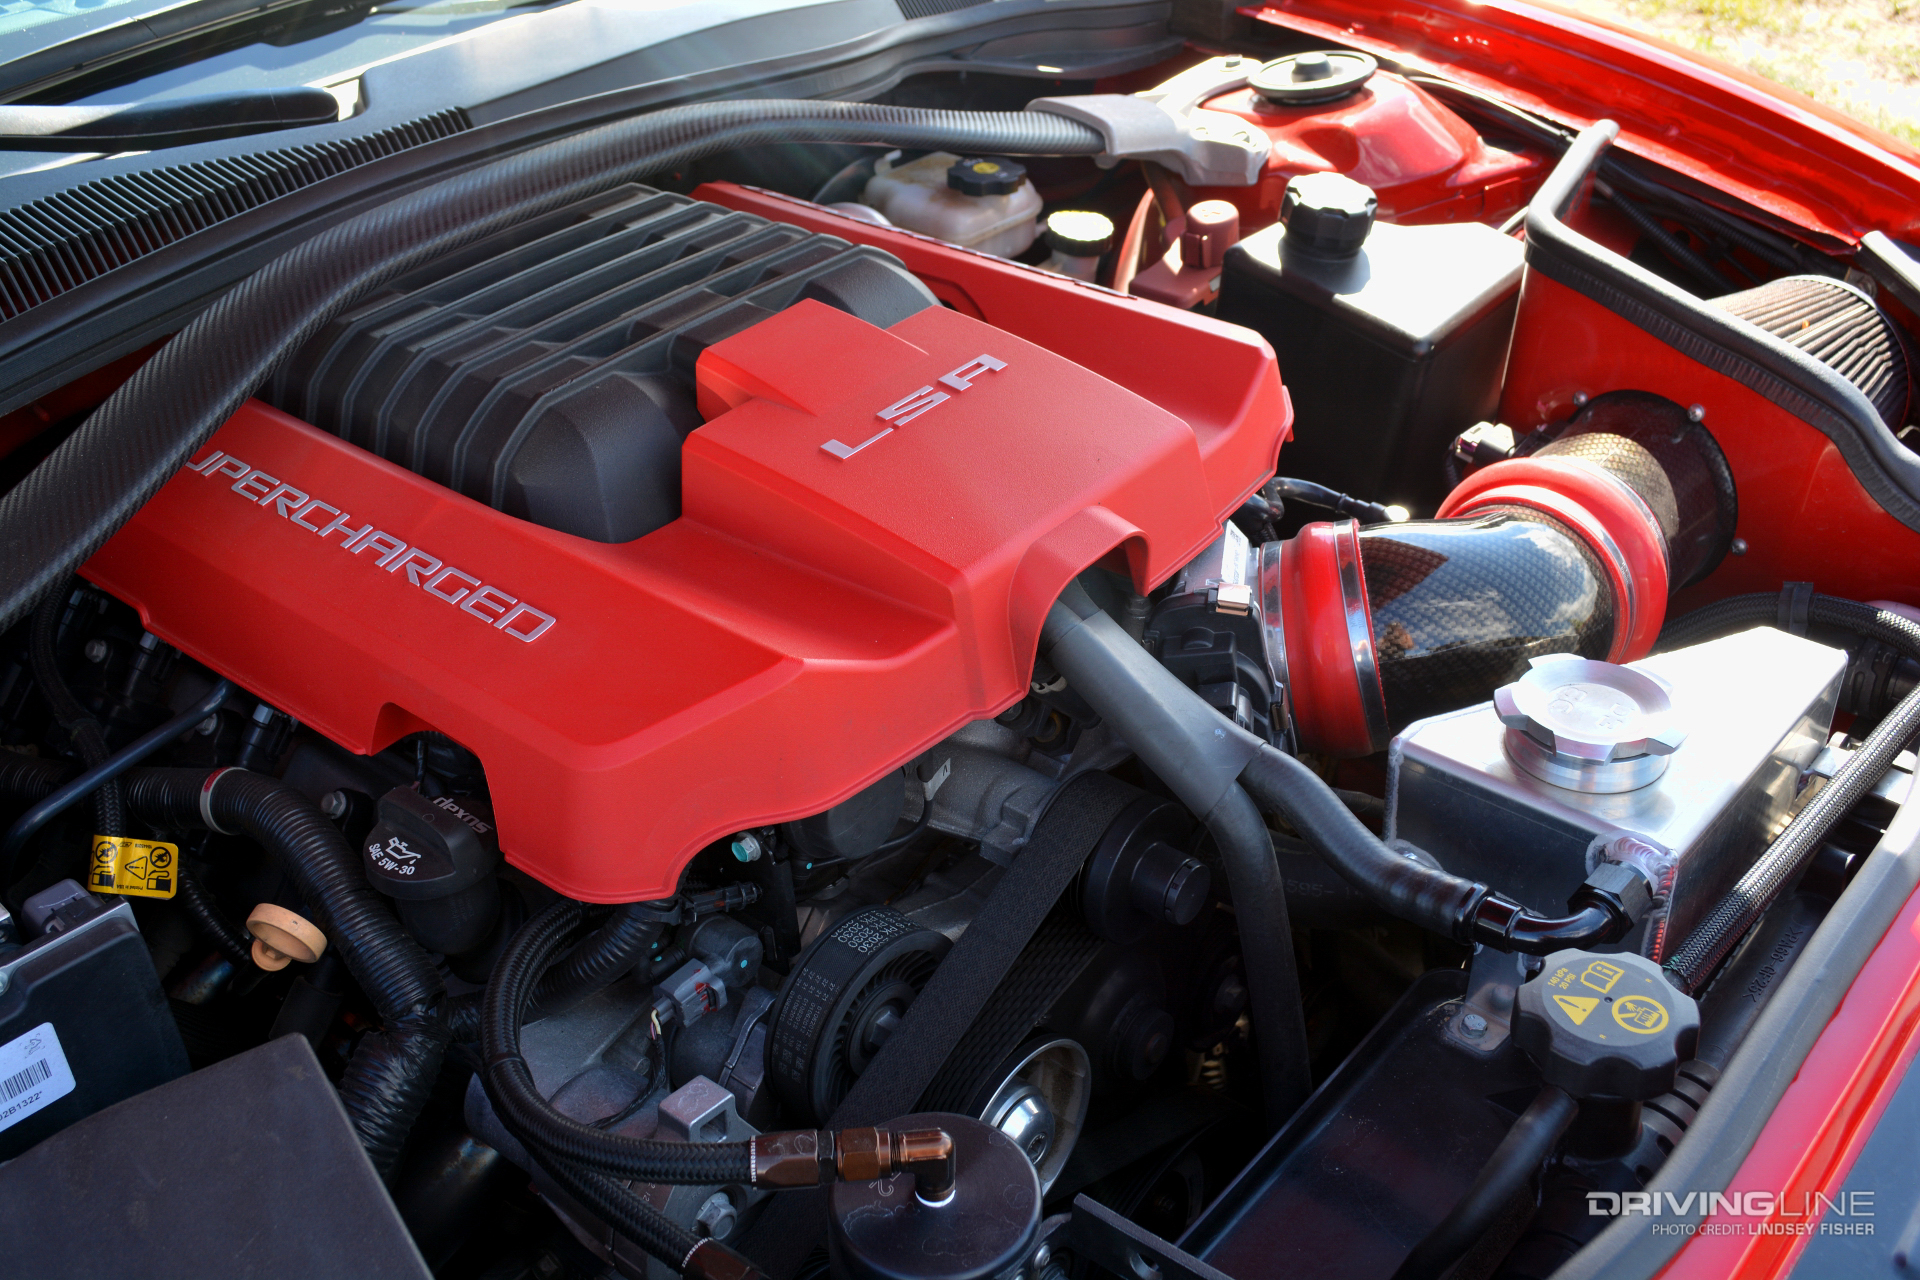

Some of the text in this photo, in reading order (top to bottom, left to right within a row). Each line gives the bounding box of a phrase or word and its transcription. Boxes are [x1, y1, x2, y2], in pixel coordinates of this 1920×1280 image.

[820, 354, 1008, 460] LSA
[185, 450, 557, 643] UPERCHARGED
[369, 843, 416, 875] SAE 5W-30
[848, 927, 874, 947] 2030
[857, 933, 883, 952] 2030
[1547, 976, 1560, 987] 140
[1559, 972, 1577, 990] 20 PSI
